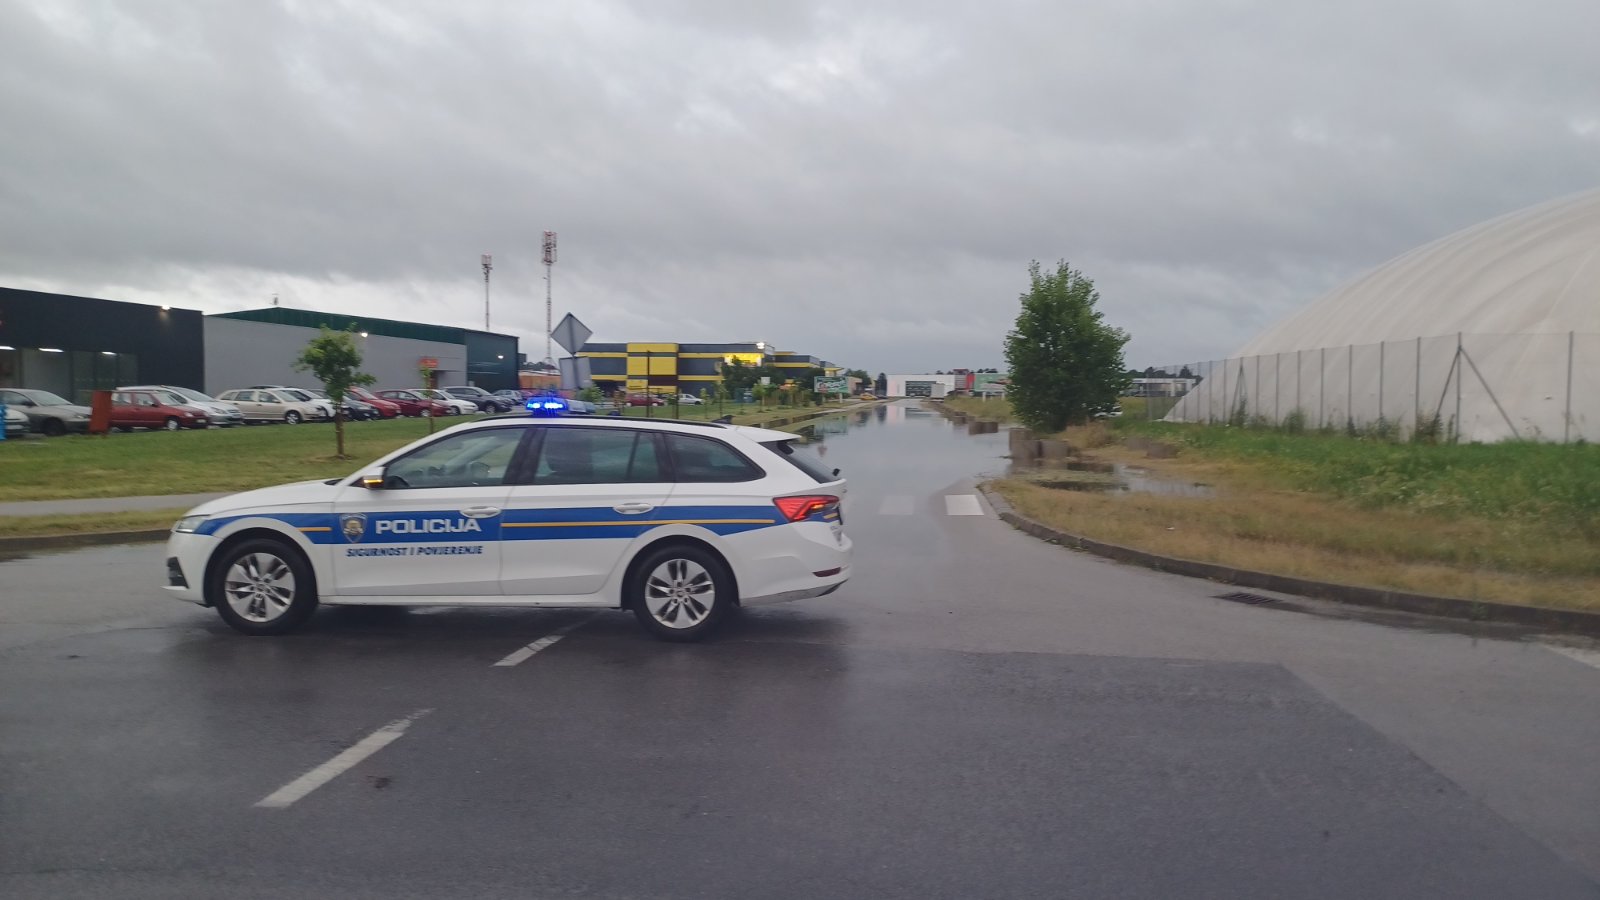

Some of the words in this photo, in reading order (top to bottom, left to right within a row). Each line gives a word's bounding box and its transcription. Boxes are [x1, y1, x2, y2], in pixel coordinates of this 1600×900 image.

[375, 519, 482, 534] POLICIJA
[347, 547, 408, 557] SIGURNOST
[417, 546, 483, 556] POVJERENJE
